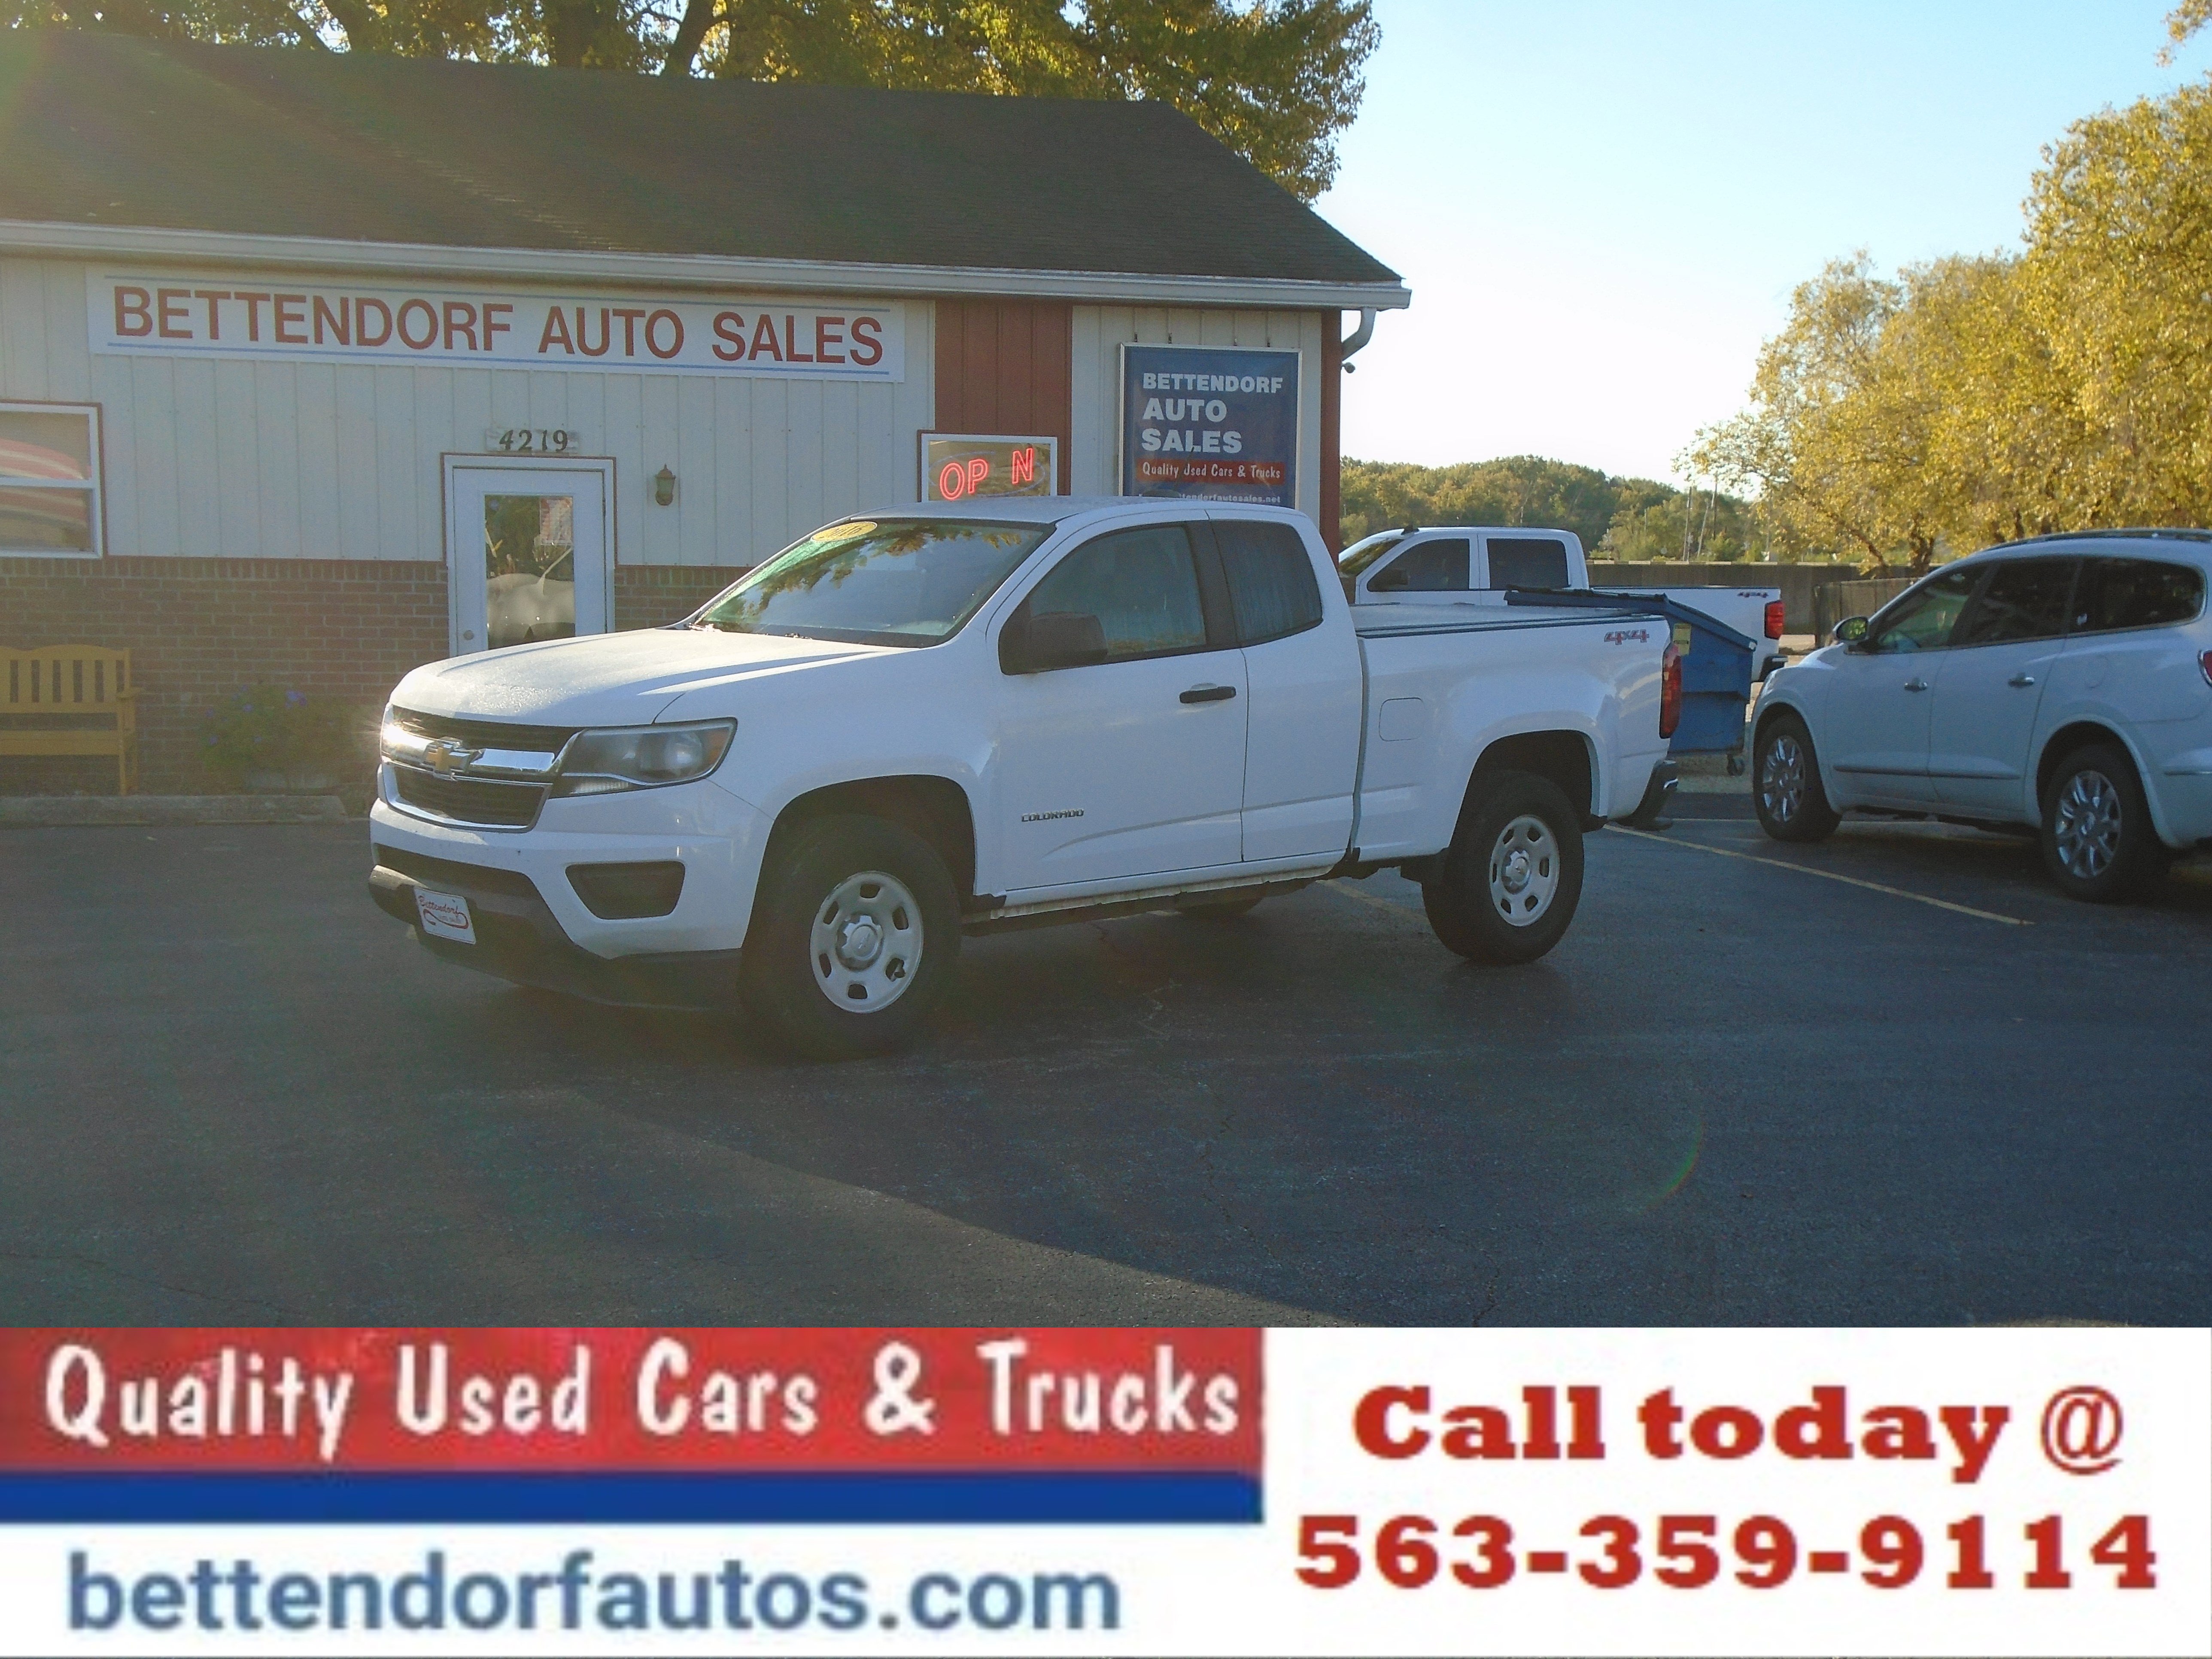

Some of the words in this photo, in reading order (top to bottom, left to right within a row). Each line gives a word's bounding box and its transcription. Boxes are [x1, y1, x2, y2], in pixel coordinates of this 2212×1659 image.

[114, 286, 513, 351] BETTENDORF
[538, 306, 684, 359] AUTO
[711, 311, 883, 366] SALES
[1143, 373, 1283, 393] BETTENDORF
[1142, 398, 1227, 422] AUTO
[499, 430, 568, 452] 4219
[1142, 428, 1242, 453] SALES
[940, 448, 1033, 500] OPN
[1142, 462, 1179, 478] Quality
[1184, 464, 1206, 476] Used
[1211, 464, 1232, 477] Cars
[1237, 465, 1246, 477] &
[1251, 465, 1281, 478] Trucks
[1604, 629, 1650, 645] 4x4
[1021, 808, 1085, 822] COLORADO
